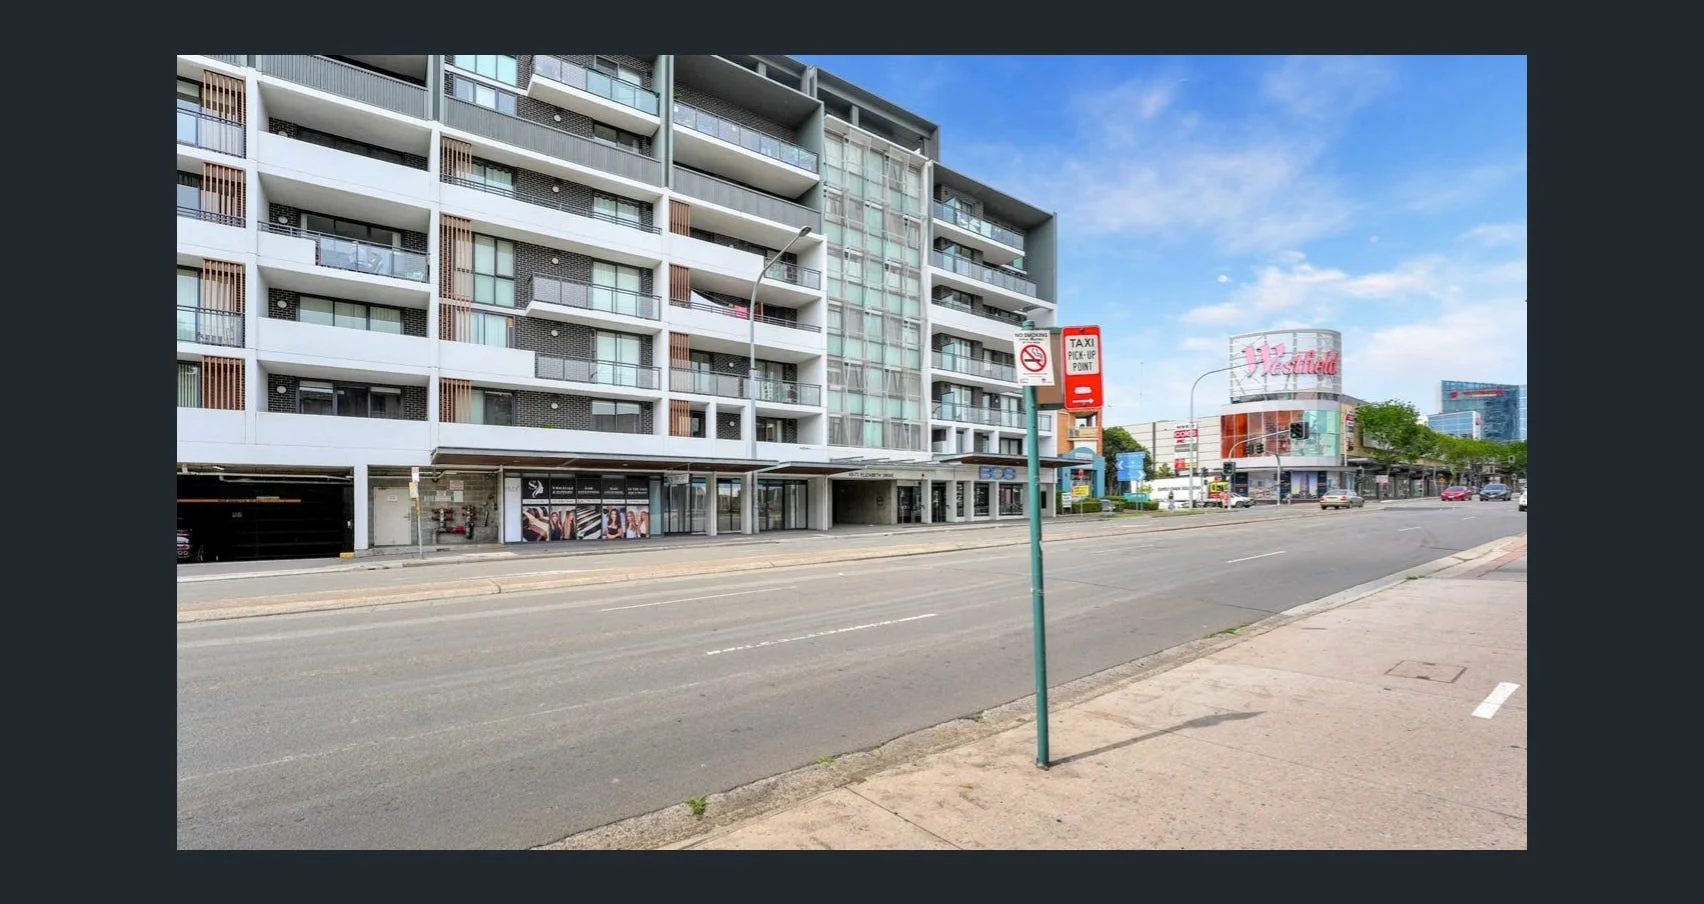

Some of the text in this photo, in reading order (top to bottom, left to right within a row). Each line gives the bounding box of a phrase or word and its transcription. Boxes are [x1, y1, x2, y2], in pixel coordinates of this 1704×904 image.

[1070, 339, 1095, 348] TAXI
[1068, 350, 1096, 360] PICK-UP
[1242, 344, 1338, 377] Westfield
[1073, 362, 1093, 371] POINT
